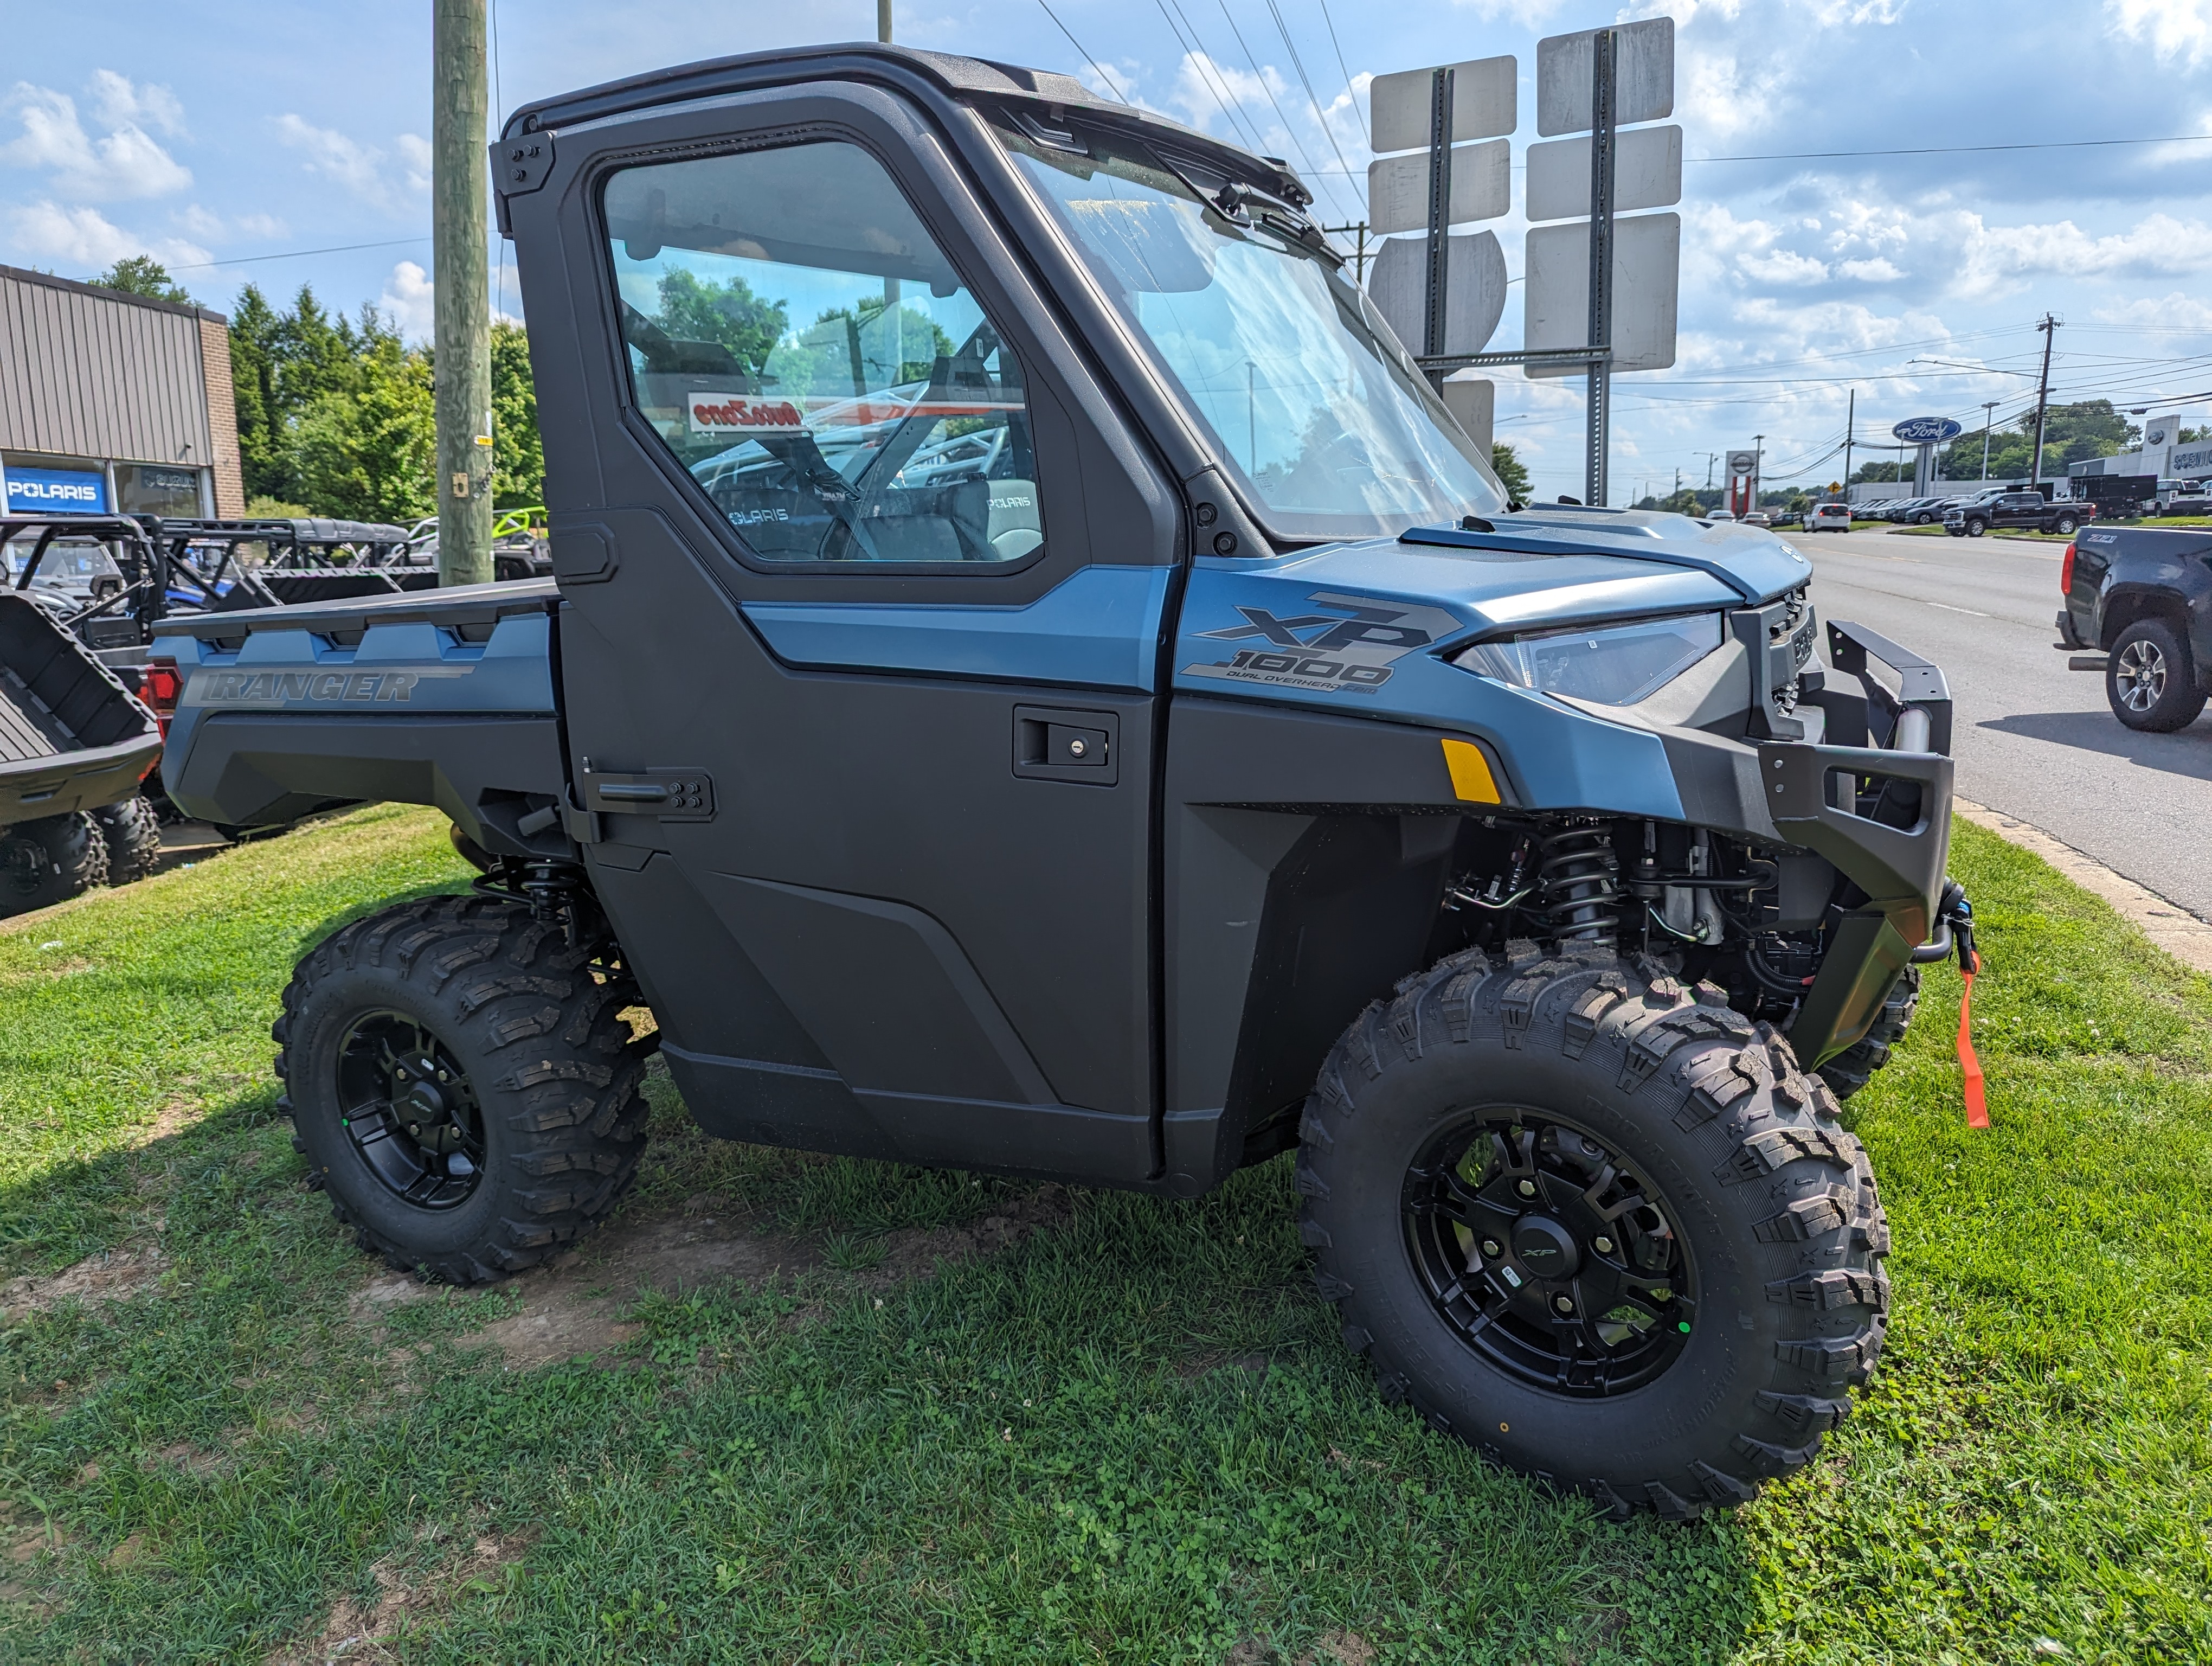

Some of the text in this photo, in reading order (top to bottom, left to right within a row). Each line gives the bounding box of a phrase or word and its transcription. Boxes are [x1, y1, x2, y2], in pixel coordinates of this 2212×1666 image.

[1907, 421, 1948, 438] Ford
[8, 481, 97, 501] POLARIS
[986, 497, 1031, 511] POLARIS
[728, 508, 789, 525] OLARIS
[2087, 534, 2118, 543] Z71
[1185, 605, 1436, 651] XP
[1231, 649, 1395, 687] 1000
[208, 672, 419, 702] RANGER
[1226, 671, 1261, 679] DUAL
[1264, 675, 1341, 689] OVERHEAD
